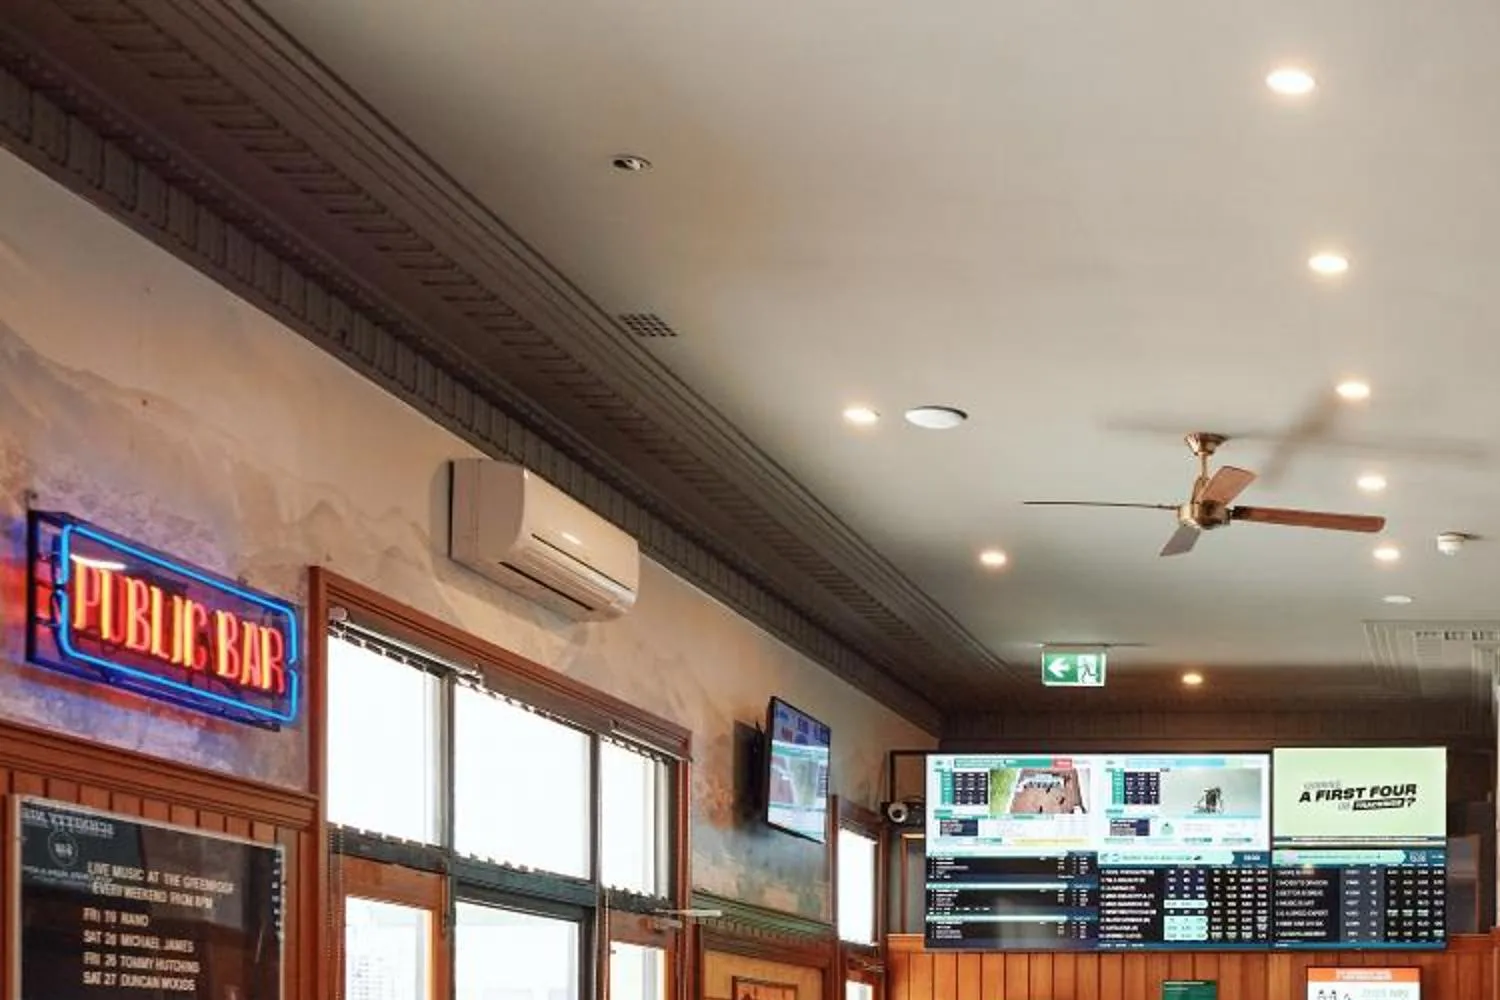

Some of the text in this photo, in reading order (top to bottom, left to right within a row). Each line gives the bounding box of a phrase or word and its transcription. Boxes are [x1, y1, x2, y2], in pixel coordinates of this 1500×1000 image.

[72, 559, 285, 694] PUBLIC BAR
[1299, 783, 1417, 803] A FIRST FOUR
[83, 929, 102, 943] SAT
[83, 971, 102, 985] SAT
